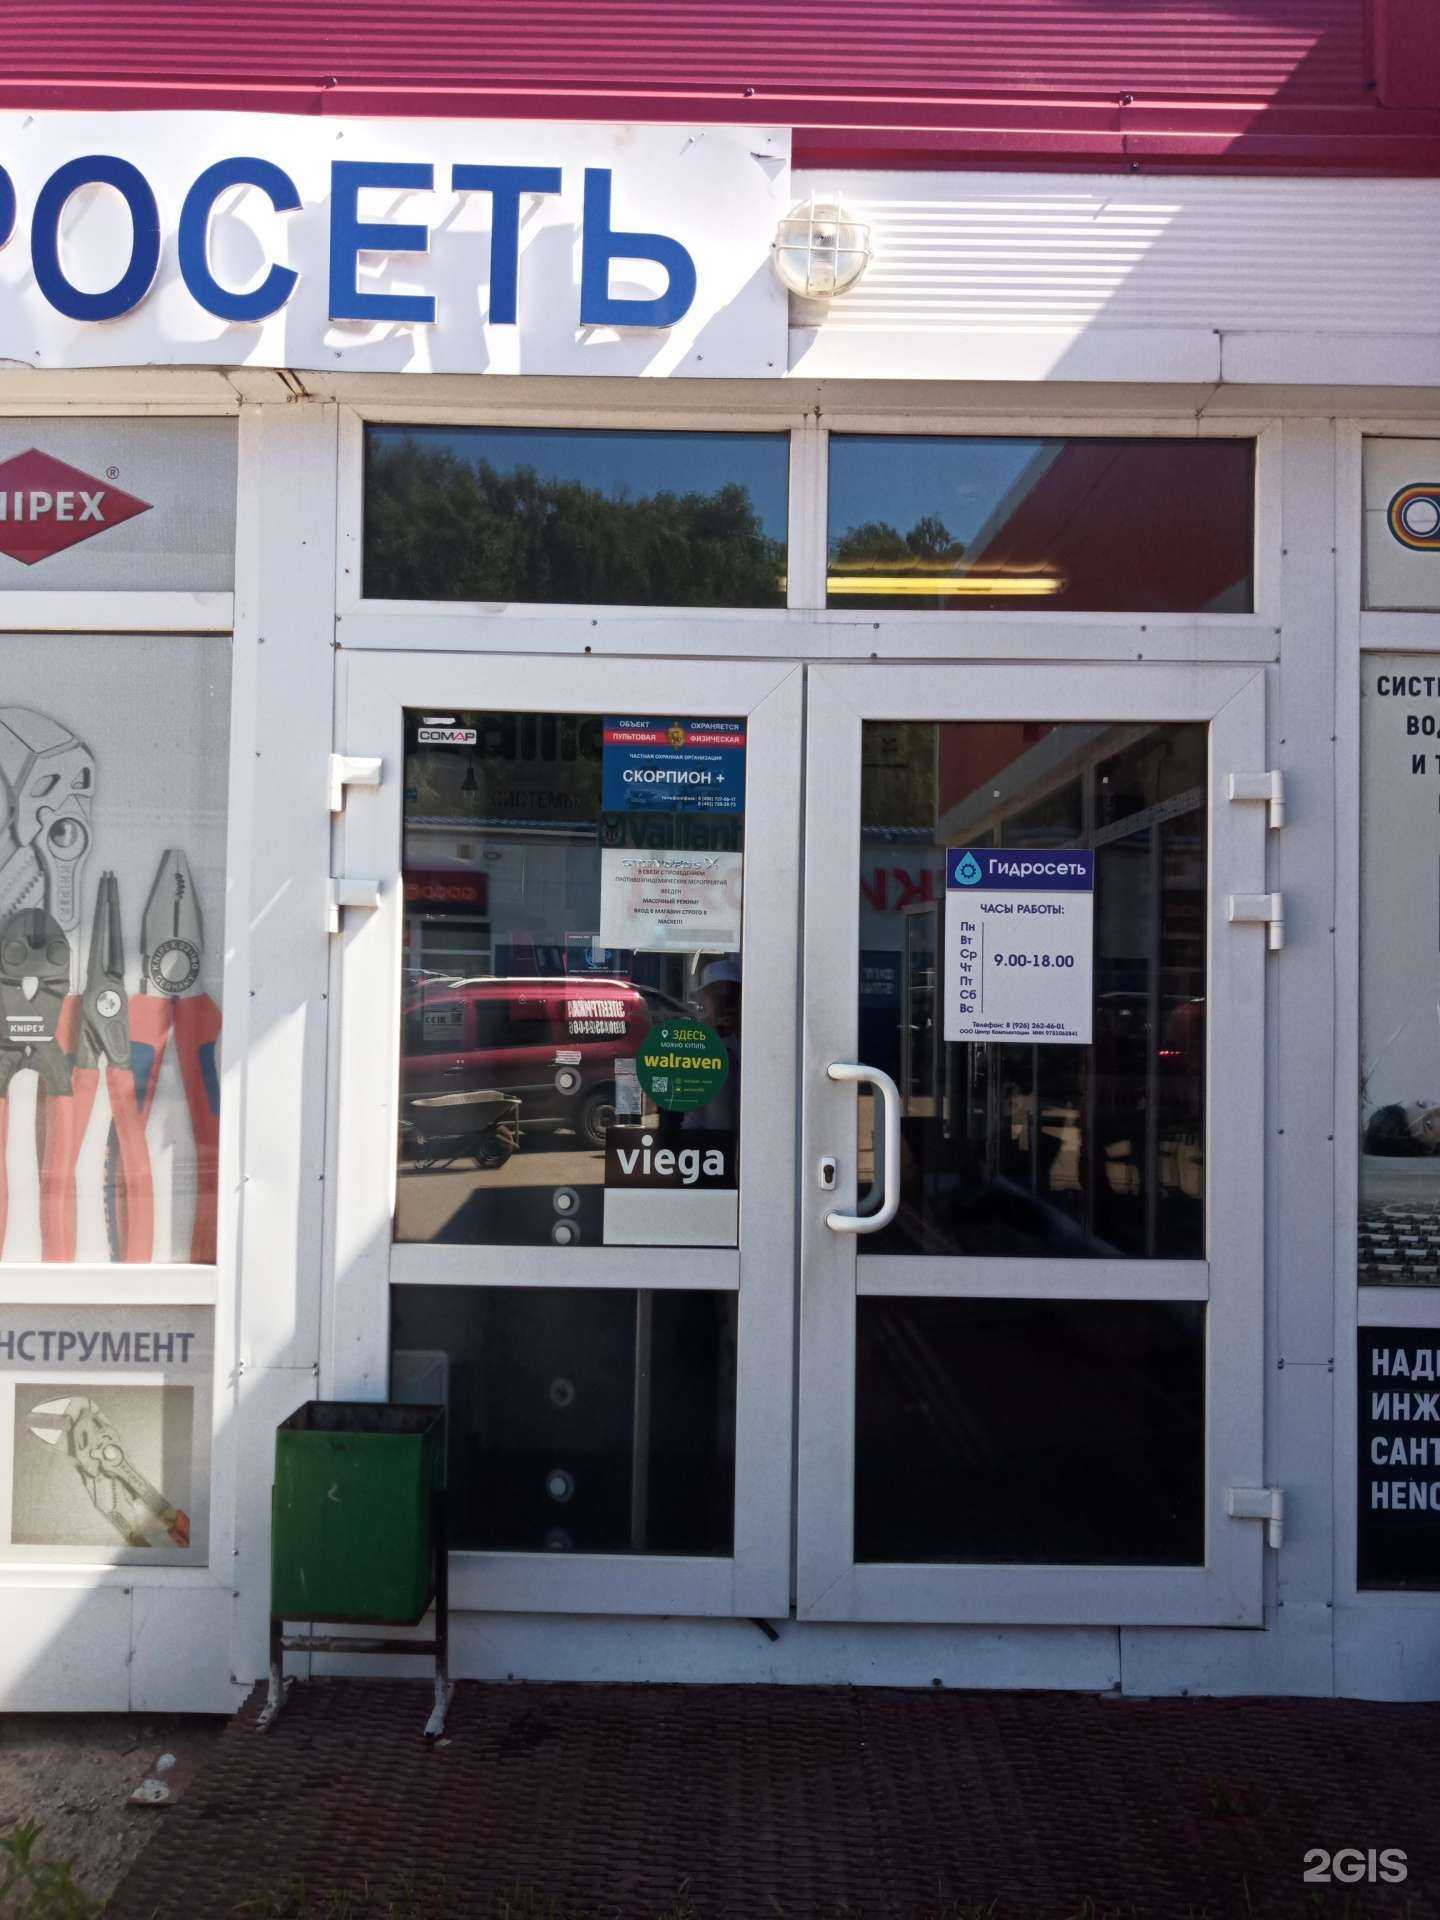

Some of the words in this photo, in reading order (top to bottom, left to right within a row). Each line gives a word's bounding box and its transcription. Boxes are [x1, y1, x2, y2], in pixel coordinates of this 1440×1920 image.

[0, 154, 698, 328] ОСЕТЬ
[1377, 675, 1440, 697] СИСТ
[619, 720, 650, 728] ОБЪЕКТ
[691, 722, 740, 730] ОХРАНЯЕТСЯ
[1407, 715, 1440, 739] ВО
[419, 730, 476, 742] COMAP
[612, 732, 656, 741] ПУЛЬТОВАЯ
[689, 735, 740, 743] ФИЗИЧЕСКАЯ
[1411, 754, 1426, 775] И
[622, 769, 712, 784] СКОРПИОН
[989, 858, 1086, 877] Гидросеть
[980, 904, 1013, 914] ЧАСЫ
[1017, 904, 1065, 914] РАБОТЫ:
[960, 922, 976, 931] Пн
[960, 935, 973, 945] Вт
[960, 949, 977, 961] Ср
[994, 954, 1074, 967] 9.00-18.00
[960, 962, 972, 972] Чт
[960, 976, 973, 986] Пт
[960, 990, 977, 999] Сб
[960, 1003, 974, 1013] Вс
[10, 1024, 45, 1032] KNIPEX
[972, 1021, 1003, 1029] Телефон:
[1012, 1022, 1030, 1030] (926)
[672, 1030, 706, 1041] ЗДЕСЬ
[644, 1053, 722, 1070] walraven
[616, 1134, 725, 1184] viega
[1371, 1348, 1440, 1381] НАД
